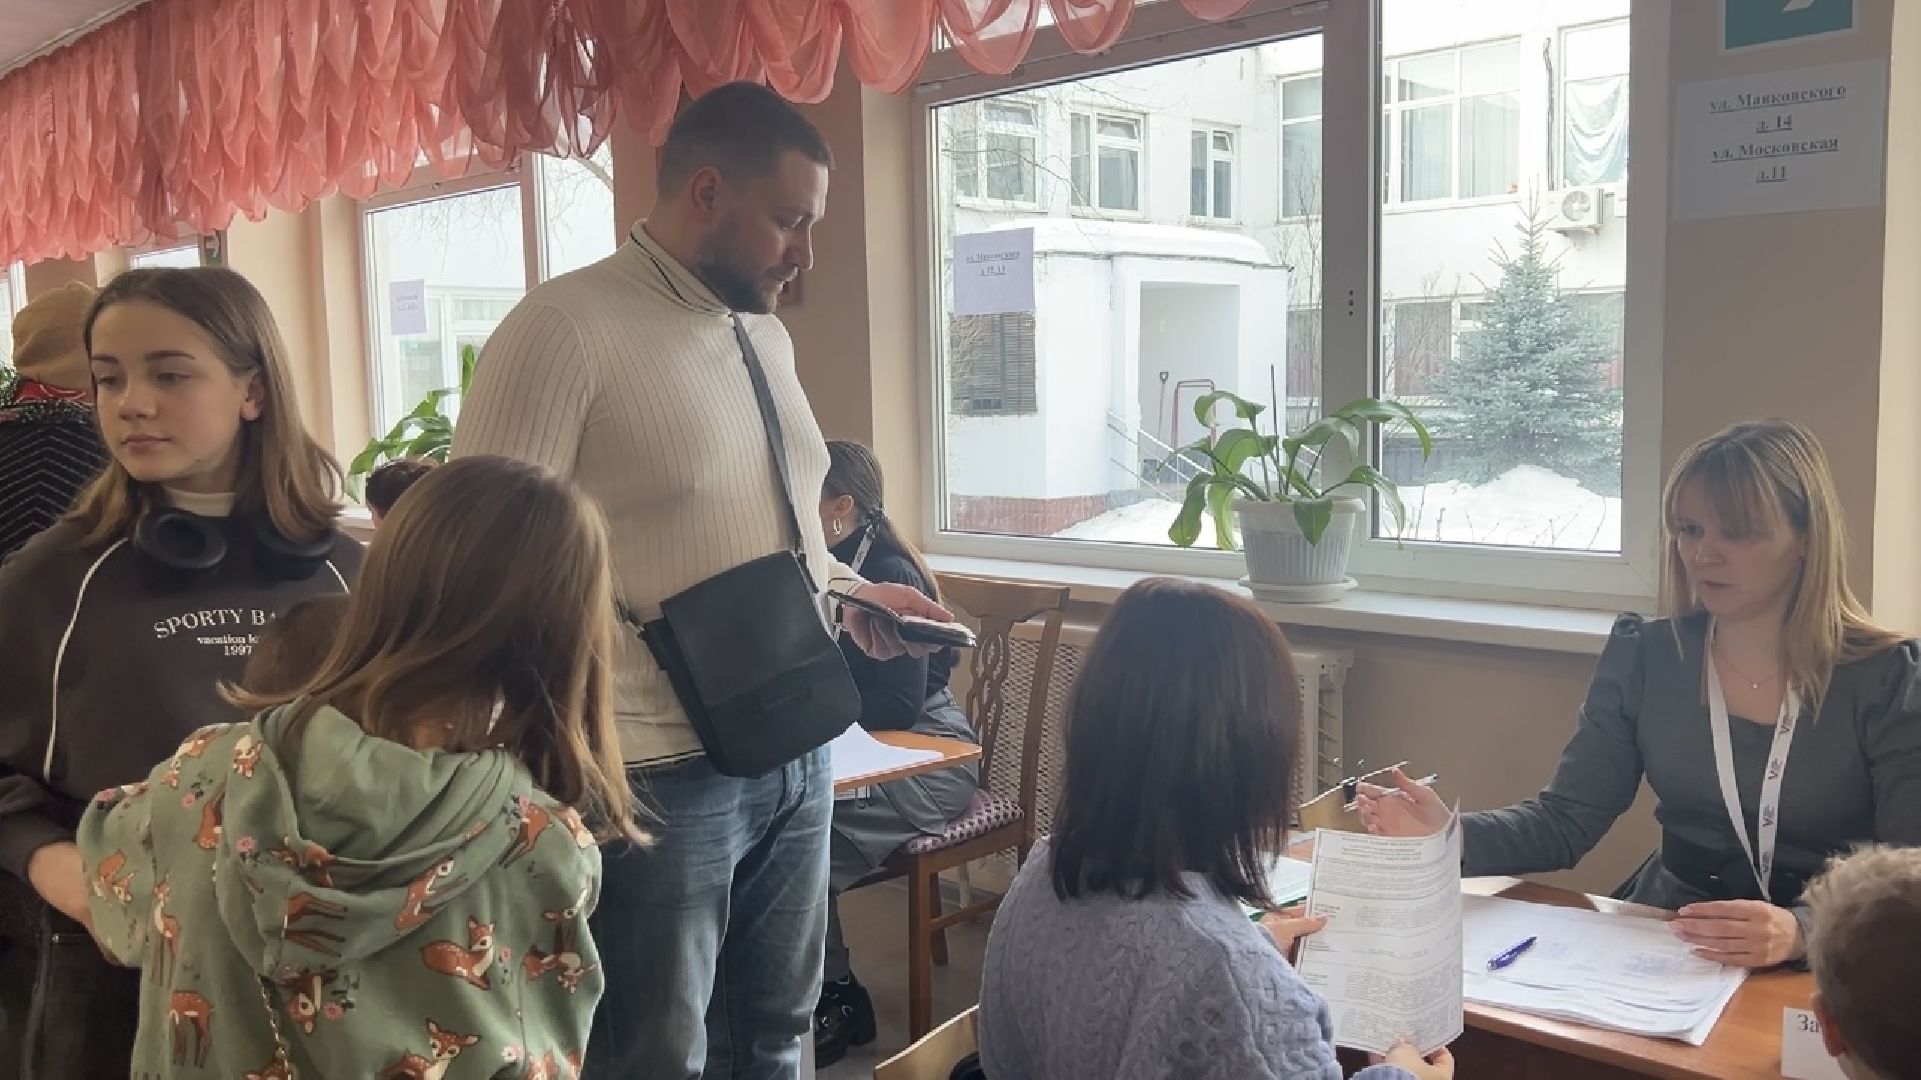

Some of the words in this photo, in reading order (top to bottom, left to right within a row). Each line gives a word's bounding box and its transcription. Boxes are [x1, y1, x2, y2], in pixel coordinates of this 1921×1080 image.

[1710, 100, 1731, 112] ул.
[1737, 85, 1847, 108] Маяковского
[1776, 114, 1793, 129] 14
[1711, 150, 1733, 161] ул.
[1740, 138, 1838, 156] Московская
[153, 608, 243, 639] SPORTY
[224, 645, 252, 656] 1997
